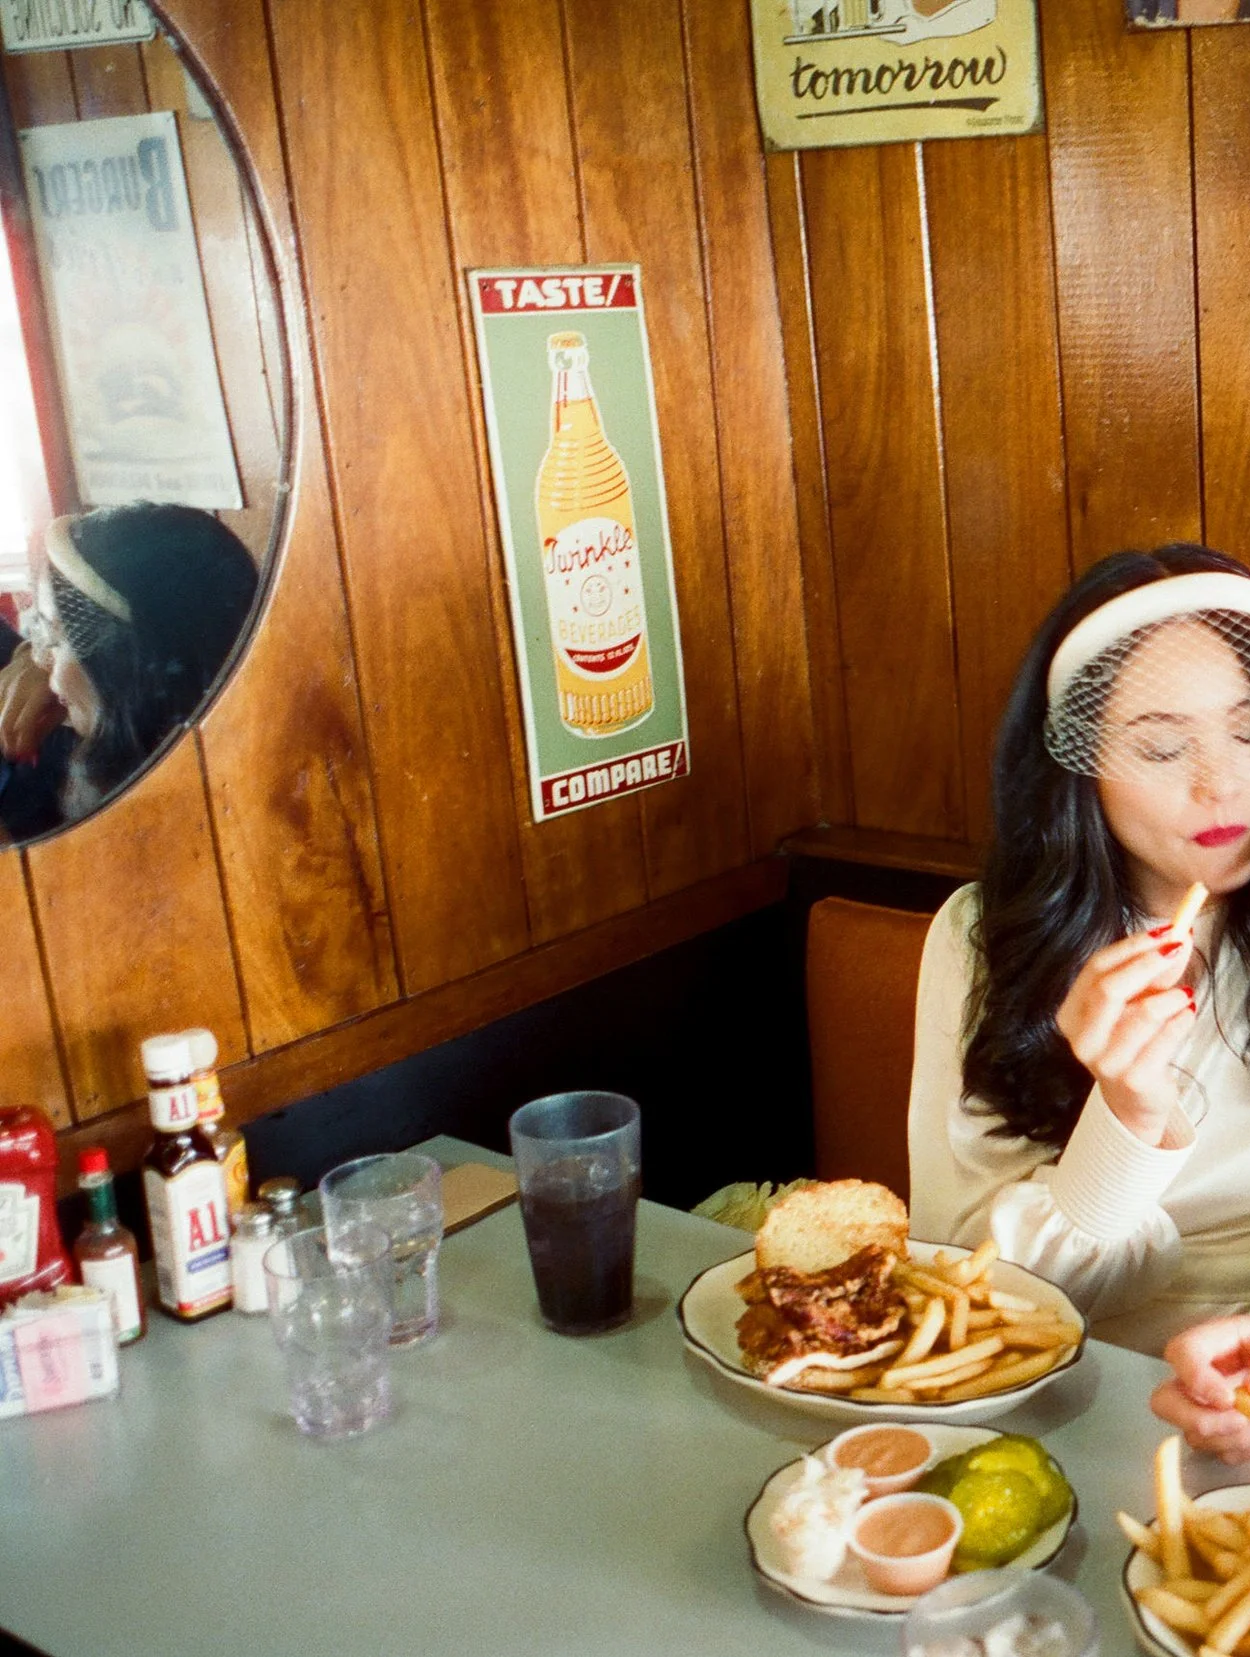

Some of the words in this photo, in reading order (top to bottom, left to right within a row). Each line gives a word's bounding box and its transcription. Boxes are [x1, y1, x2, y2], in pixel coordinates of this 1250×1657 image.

[789, 45, 1007, 99] tomorrow
[543, 524, 633, 575] Twinkle
[558, 605, 642, 645] BEVERAGES
[552, 742, 683, 808] COMPARE!
